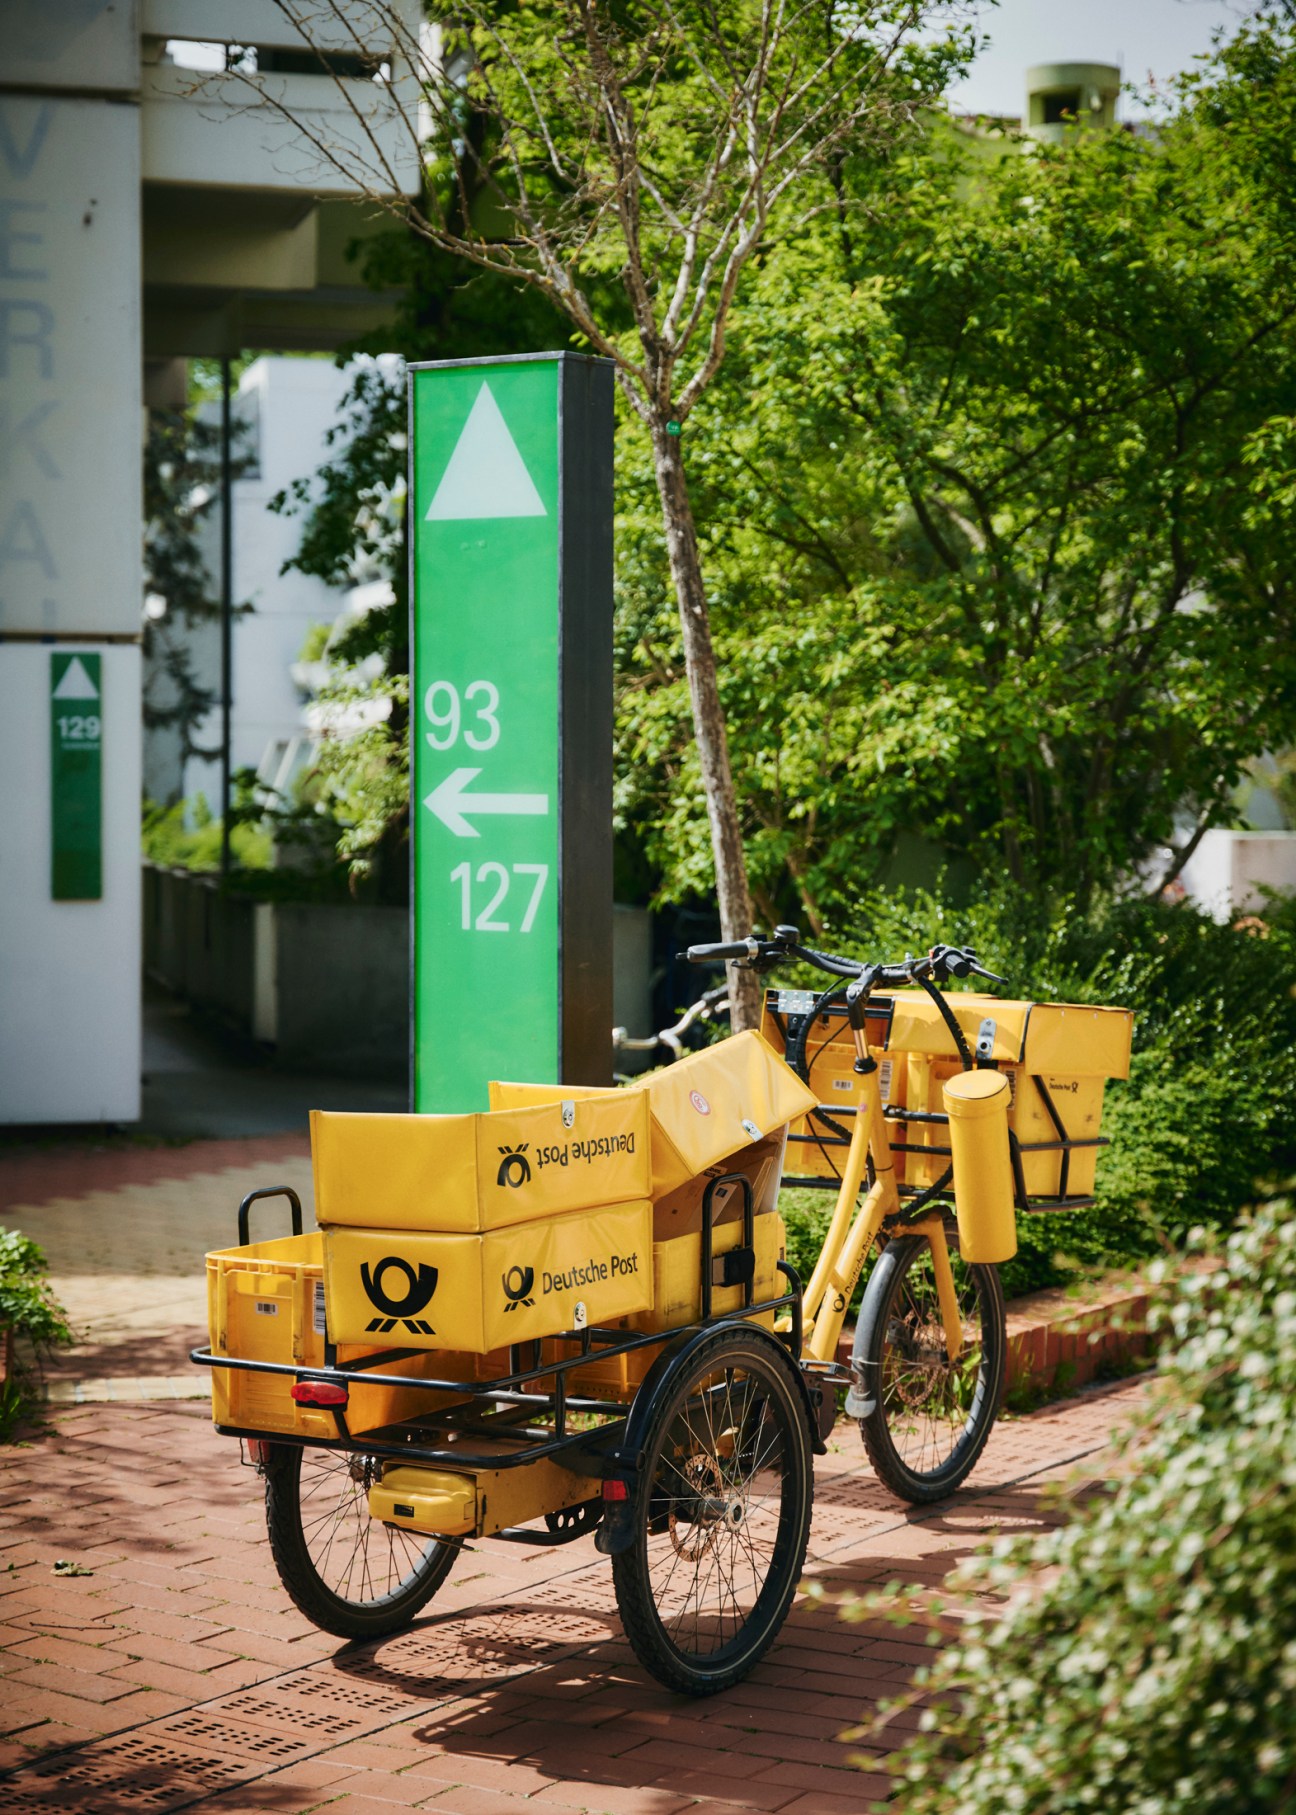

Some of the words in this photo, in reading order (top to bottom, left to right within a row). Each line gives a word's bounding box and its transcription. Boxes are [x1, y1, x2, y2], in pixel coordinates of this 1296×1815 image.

[57, 715, 101, 740] 129
[424, 680, 500, 751] 93
[450, 861, 549, 933] 127
[537, 1144, 569, 1169] Post
[571, 1132, 635, 1164] Deutsche
[542, 1259, 608, 1295] Deutsche
[611, 1252, 638, 1278] Post
[845, 1252, 865, 1295] Deutsche
[862, 1231, 875, 1253] Post
